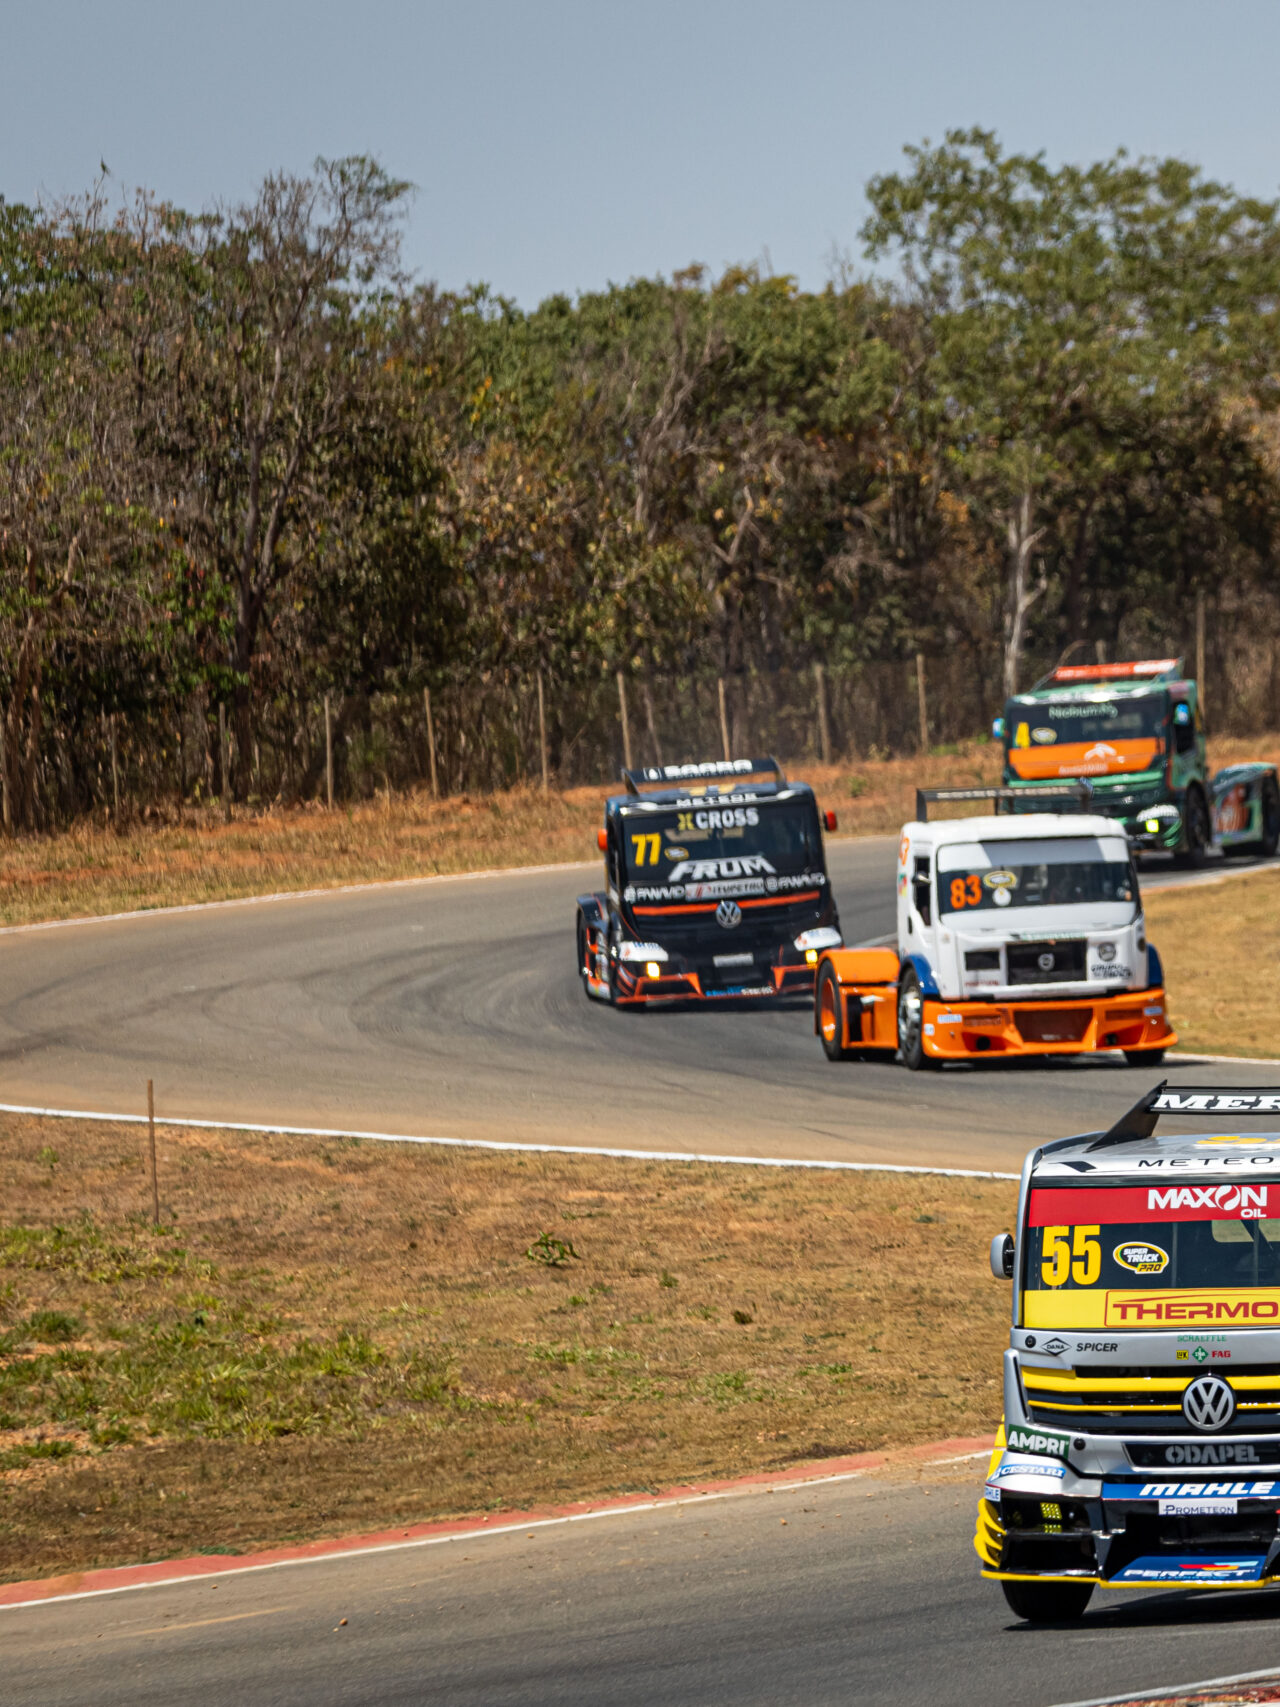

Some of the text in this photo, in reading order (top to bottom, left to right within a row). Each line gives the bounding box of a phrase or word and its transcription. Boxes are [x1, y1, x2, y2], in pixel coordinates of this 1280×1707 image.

[631, 833, 662, 866] 77
[950, 874, 982, 909] 83
[1148, 1185, 1268, 1211] MAXON
[1240, 1208, 1267, 1218] OIL
[1041, 1225, 1102, 1287] 55
[1123, 1247, 1149, 1256] SUPER
[1127, 1253, 1160, 1263] TRUCK
[1139, 1263, 1162, 1273] PRO
[1076, 1342, 1118, 1352] SPICER
[1211, 1350, 1232, 1358] FAG
[1008, 1430, 1065, 1455] AMPRI
[1165, 1444, 1260, 1464] ODAPEL
[1001, 1465, 1064, 1478] CESTARI
[1139, 1481, 1276, 1497] MAHLE
[1163, 1504, 1234, 1515] PROMETEON
[1124, 1569, 1252, 1577] PERFECT
